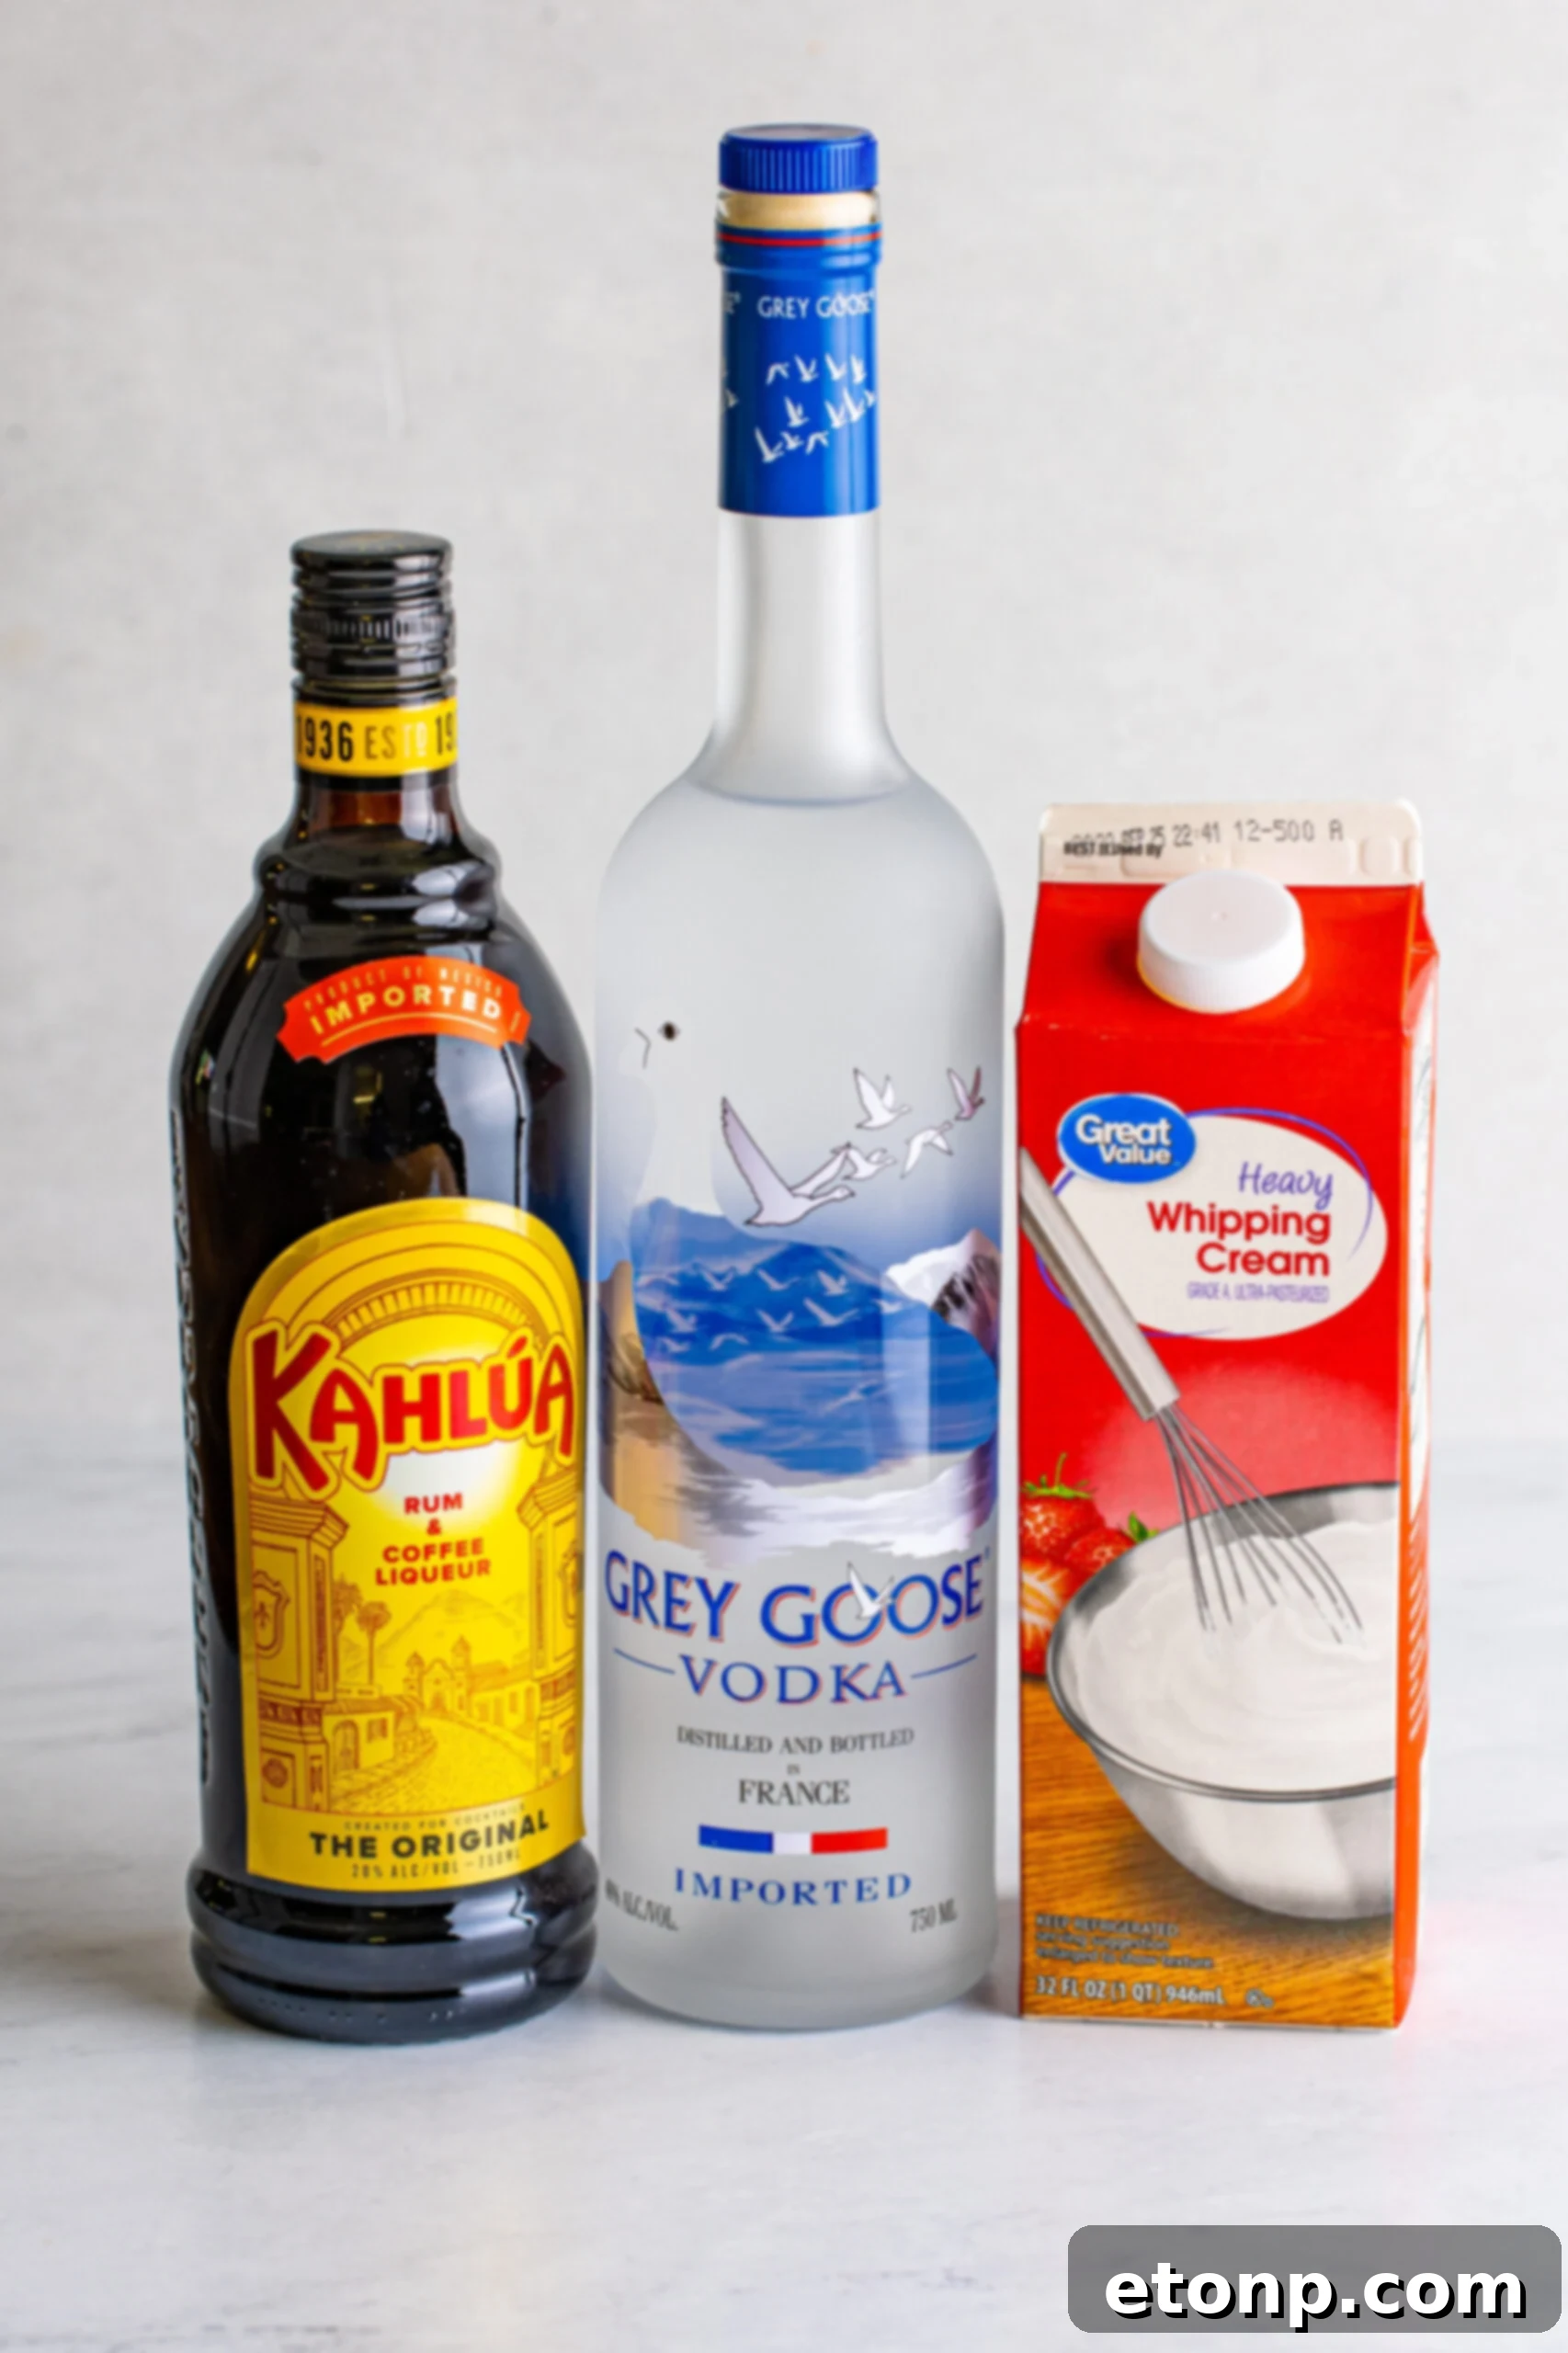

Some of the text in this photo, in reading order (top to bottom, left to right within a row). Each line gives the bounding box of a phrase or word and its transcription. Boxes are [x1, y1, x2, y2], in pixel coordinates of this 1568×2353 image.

[757, 295, 810, 319] GREY
[816, 292, 873, 318] GOOSE
[297, 717, 354, 762] 1936
[1234, 819, 1315, 843] 12-500
[1329, 819, 1344, 842] A
[310, 984, 501, 1035] IMPORTED
[1075, 1113, 1173, 1146] Great
[1101, 1144, 1172, 1165] Value
[1238, 1161, 1334, 1211] Heavy
[1147, 1201, 1332, 1245] Whipping
[1197, 1242, 1331, 1277] Cream
[251, 1328, 574, 1493] KAHLÚA
[404, 1493, 463, 1515] RUM
[426, 1518, 442, 1536] &
[382, 1538, 484, 1563] COFFEE
[375, 1559, 491, 1586] LIQUEUR
[605, 1550, 984, 1649] GREY GOOSE
[679, 1654, 908, 1705] VODKA
[676, 1725, 915, 1755] DISTILLED AND BOTTLED
[738, 1779, 850, 1806] FRANCE
[309, 1808, 550, 1859] THE ORIGINAL
[344, 1821, 412, 1832] CREATED
[419, 1819, 447, 1829] FOR
[675, 1868, 912, 1906] IMPORTED
[1036, 1975, 1056, 1995] 32
[1062, 1977, 1079, 1997] FL
[1085, 1980, 1107, 1999] OZ
[1165, 1984, 1224, 2005] 946mL
